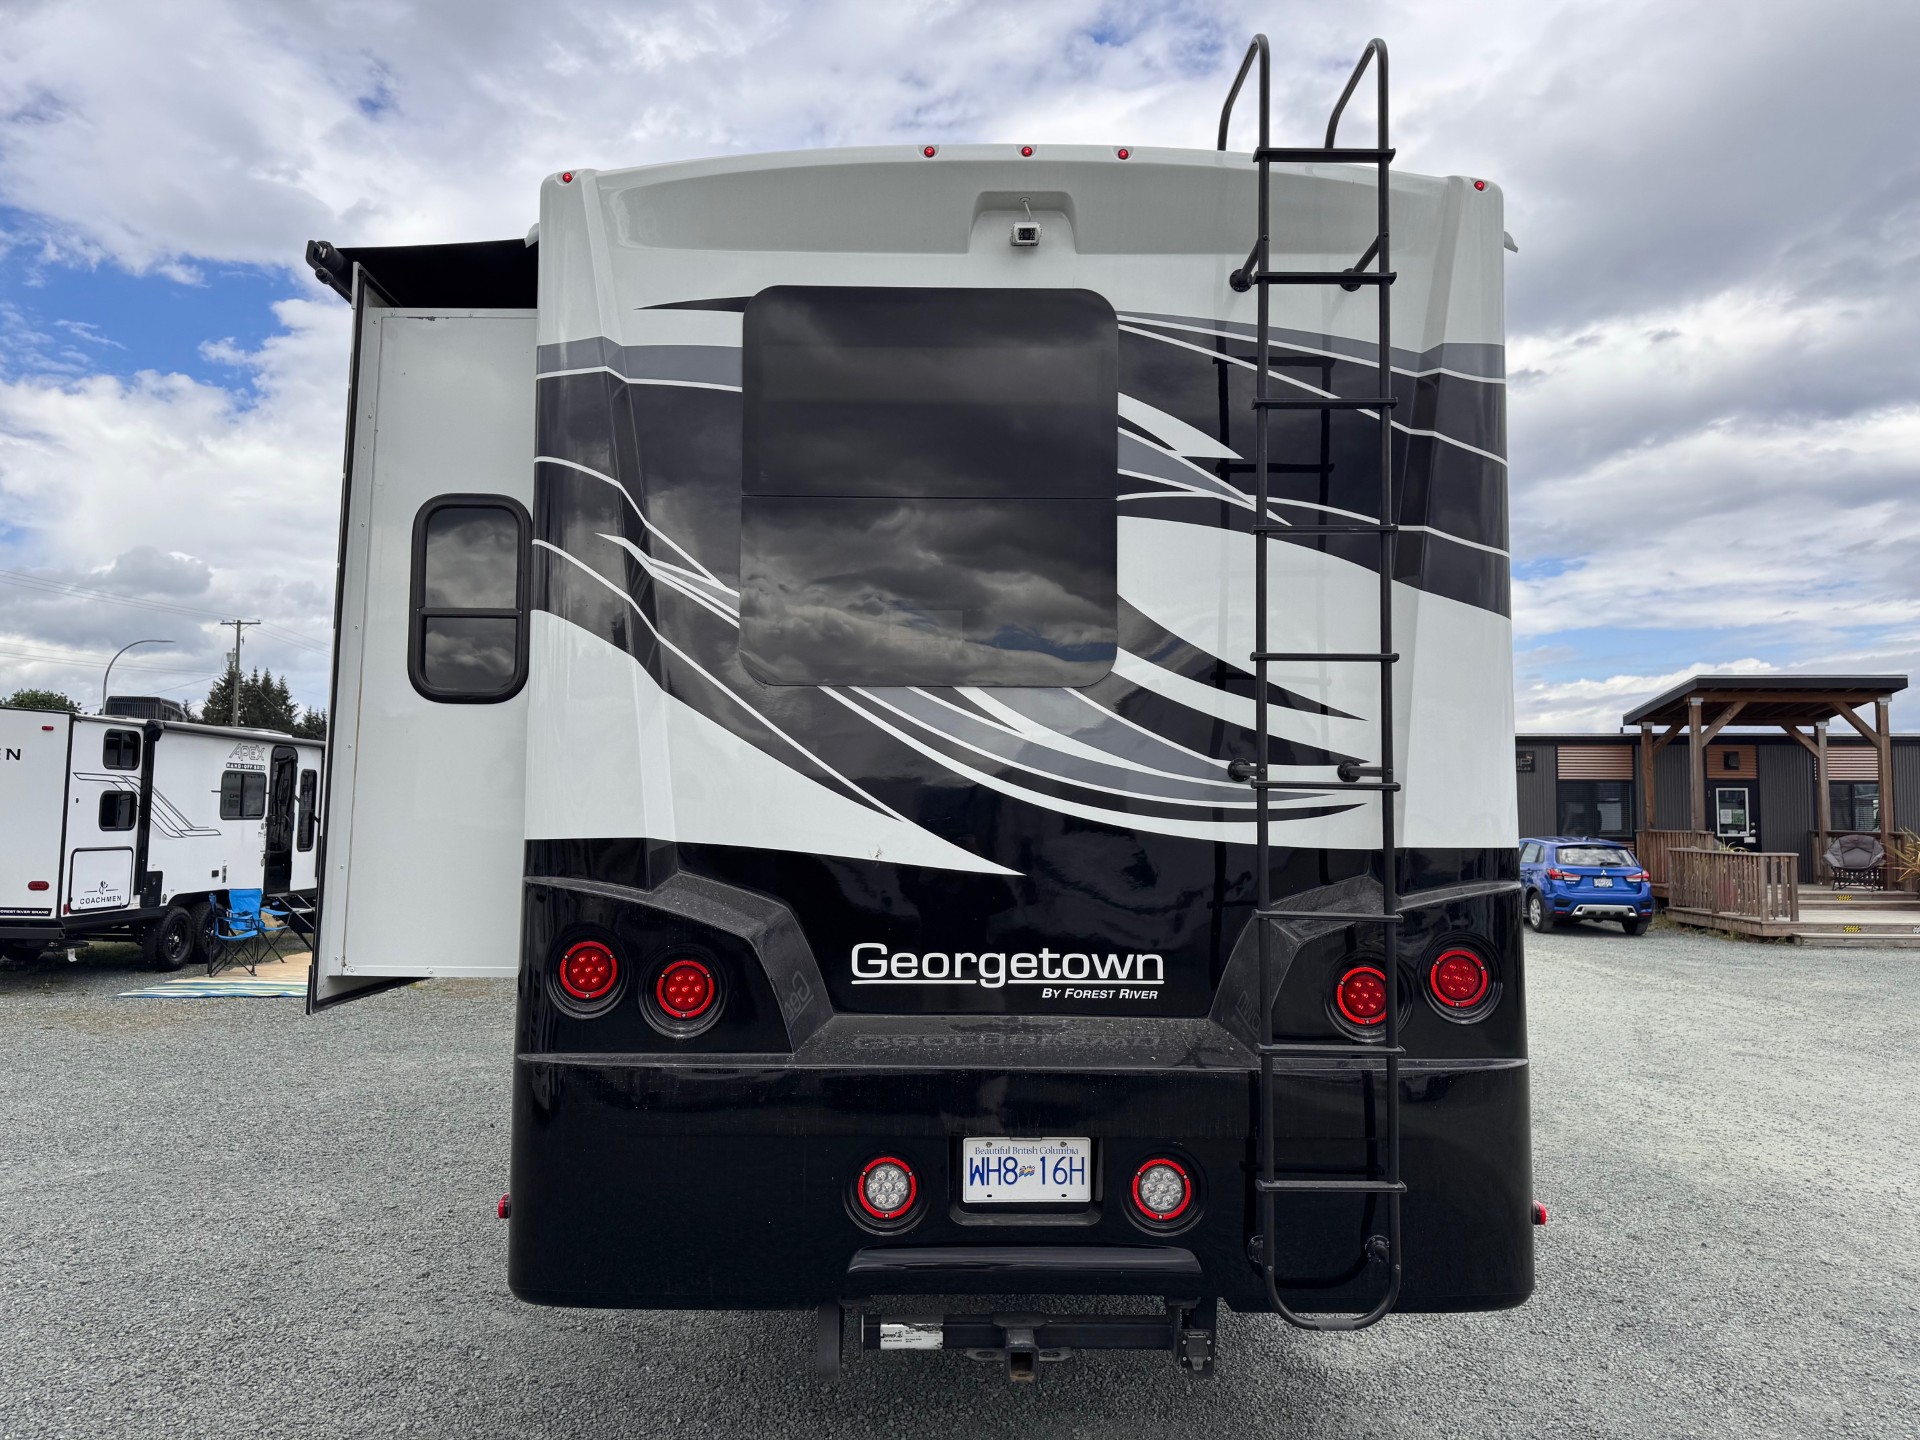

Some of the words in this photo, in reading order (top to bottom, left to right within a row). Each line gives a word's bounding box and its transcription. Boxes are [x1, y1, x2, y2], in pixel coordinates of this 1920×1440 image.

[0, 748, 21, 761] N
[79, 895, 122, 905] COACHMEN
[851, 942, 1164, 988] Georgetown
[1064, 988, 1116, 999] FOREST
[1118, 988, 1159, 1000] RIVER
[975, 1146, 1011, 1155] Beautiful
[1012, 1146, 1038, 1155] British
[1039, 1146, 1079, 1155] Columbia
[969, 1156, 1018, 1186] WH8
[1039, 1156, 1085, 1185] 16H
